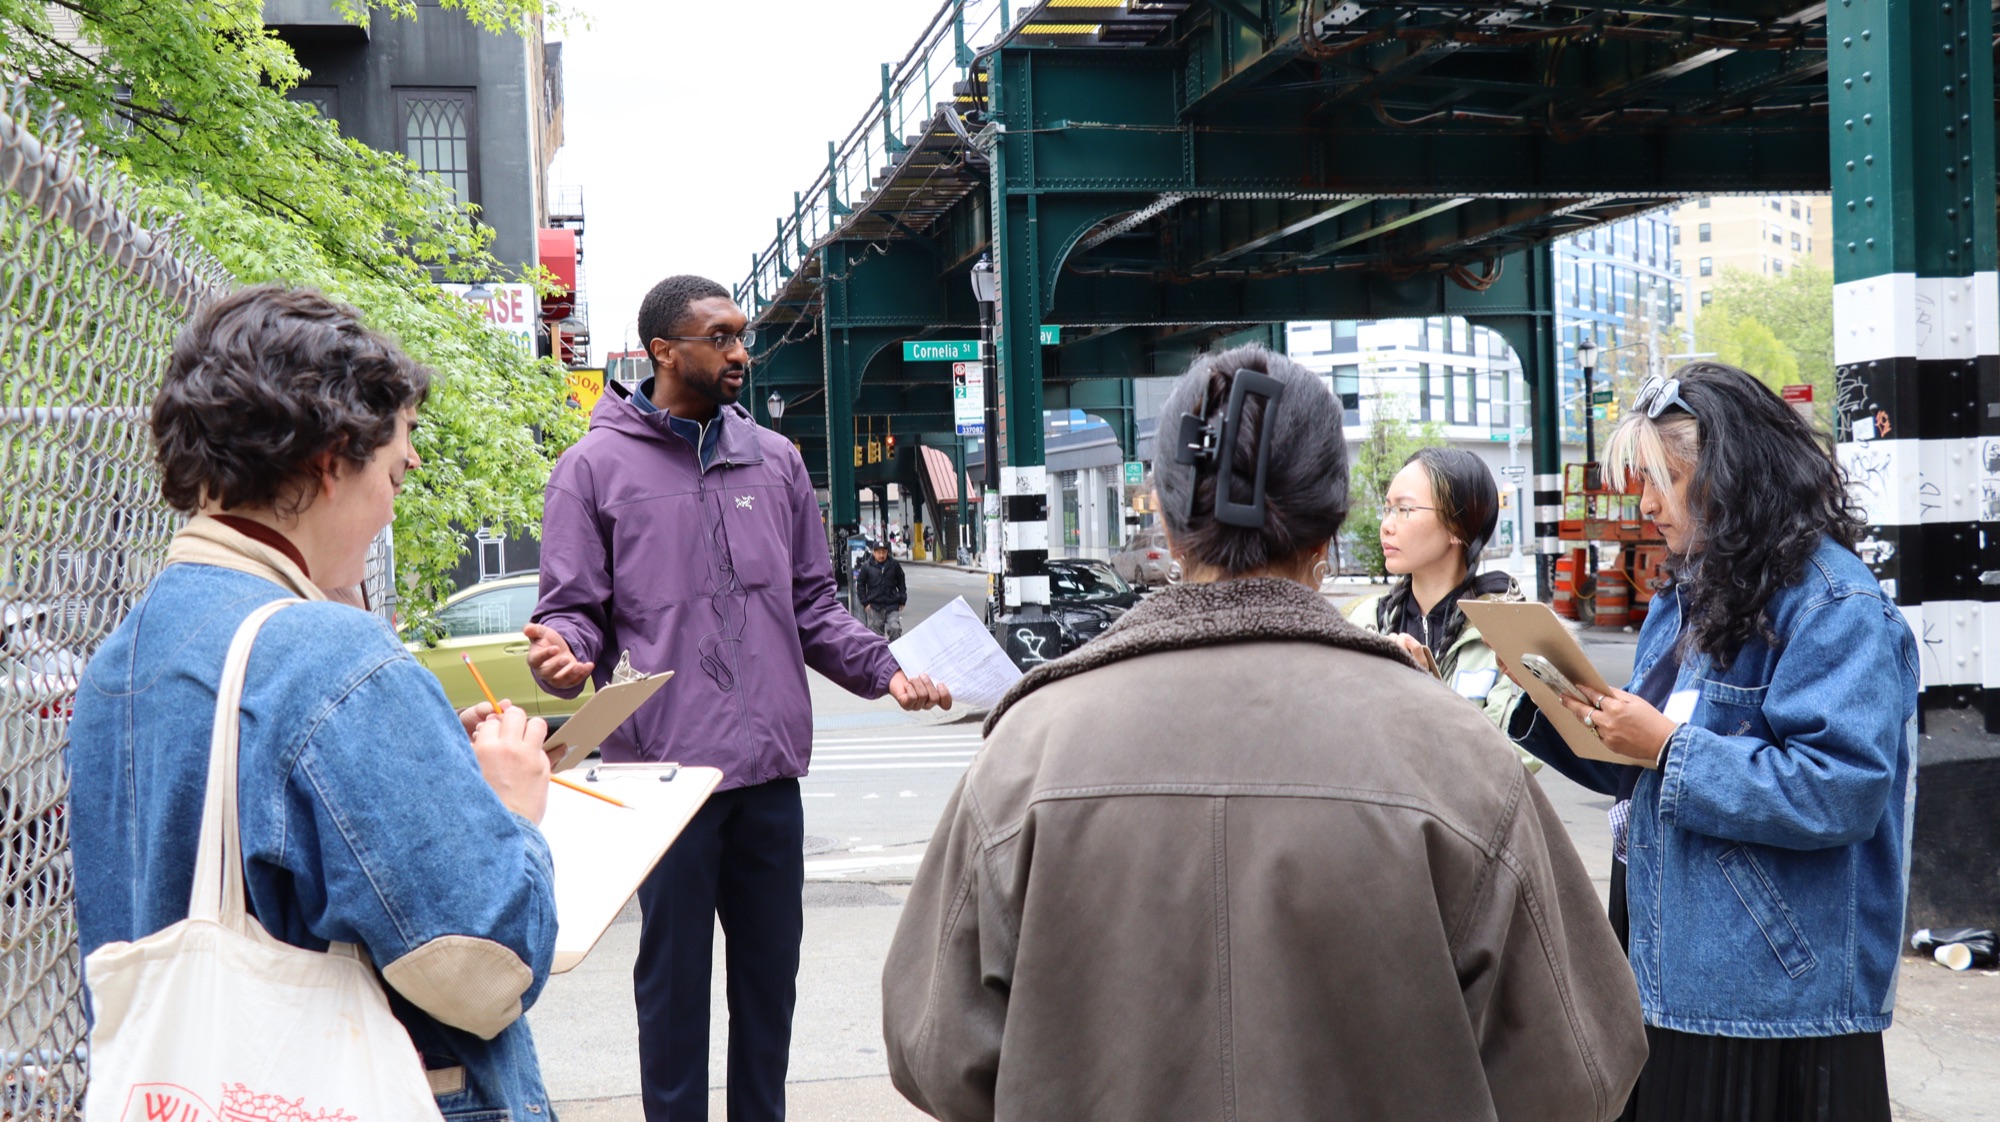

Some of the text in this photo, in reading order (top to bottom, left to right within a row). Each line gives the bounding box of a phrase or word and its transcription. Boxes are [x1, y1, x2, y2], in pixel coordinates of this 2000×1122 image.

[1040, 331, 1052, 345] ay
[913, 343, 971, 359] Cornelia St
[957, 388, 965, 398] 2
